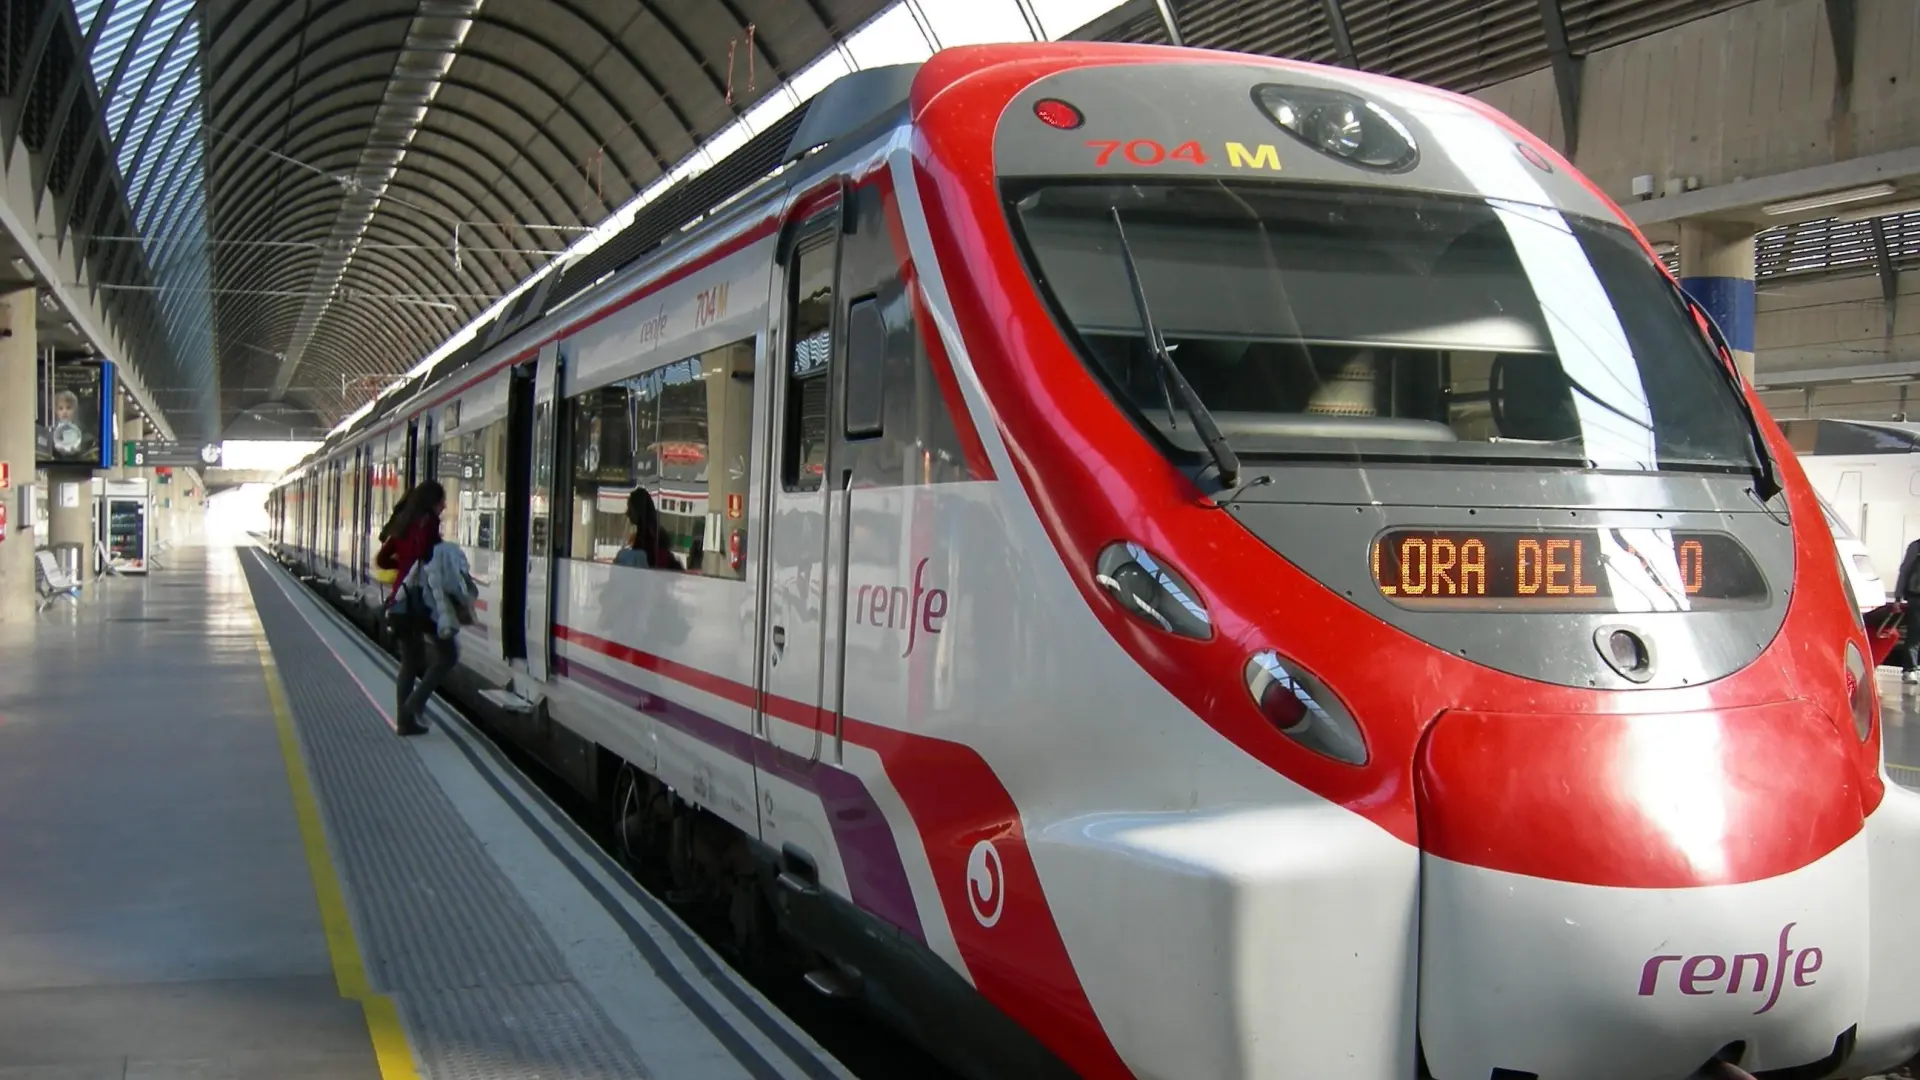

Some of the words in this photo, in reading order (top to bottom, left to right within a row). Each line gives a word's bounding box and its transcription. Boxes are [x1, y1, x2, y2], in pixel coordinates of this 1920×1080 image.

[1085, 139, 1208, 168] 704
[1225, 142, 1282, 171] M
[640, 302, 668, 351] renfe
[695, 286, 717, 329] 704
[135, 453, 144, 465] 8
[1517, 538, 1597, 595] DEL
[856, 557, 949, 658] renfe
[1638, 921, 1823, 1015] renfe
